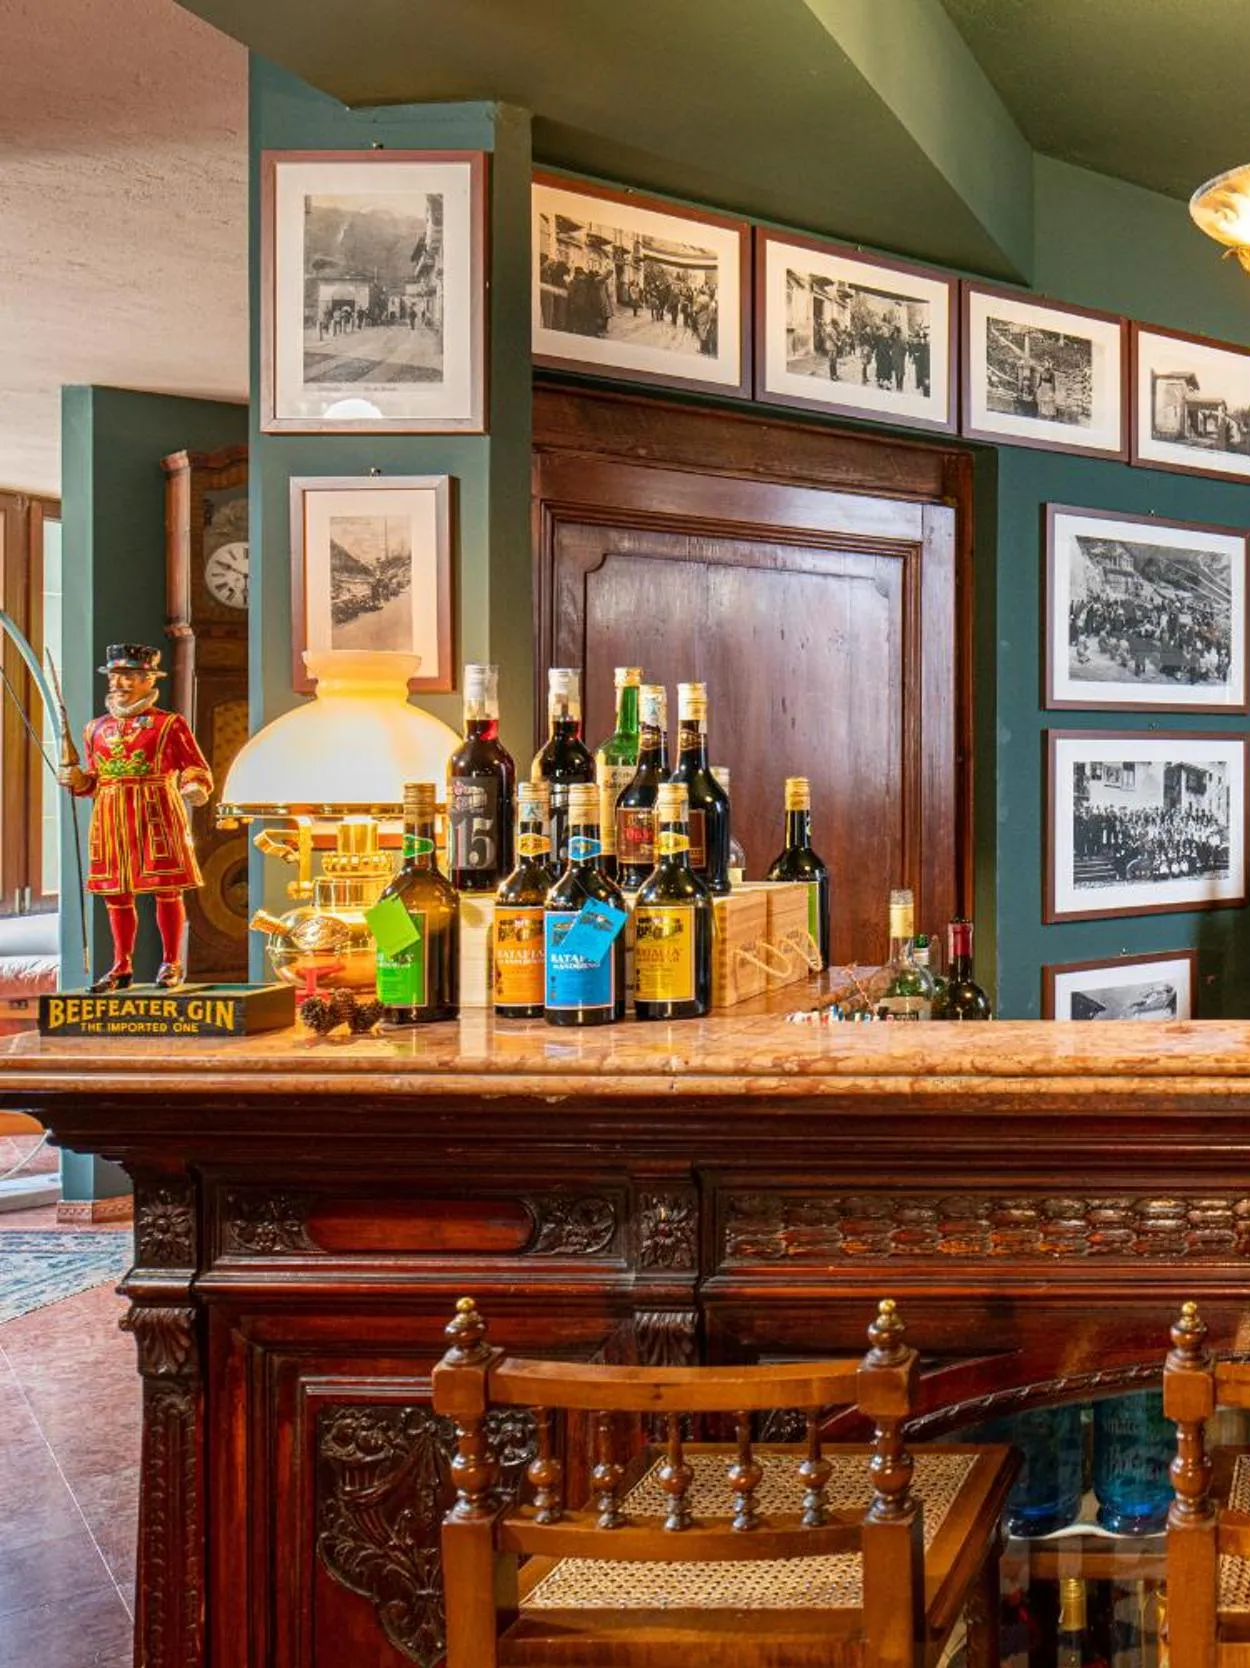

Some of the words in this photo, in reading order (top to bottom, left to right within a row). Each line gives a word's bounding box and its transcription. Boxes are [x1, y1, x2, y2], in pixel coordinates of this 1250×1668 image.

[454, 817, 496, 870] 15
[80, 1021, 103, 1032] THE
[107, 1021, 168, 1032] IMPORTED
[172, 1021, 199, 1032] ONE
[187, 999, 235, 1030] GIN
